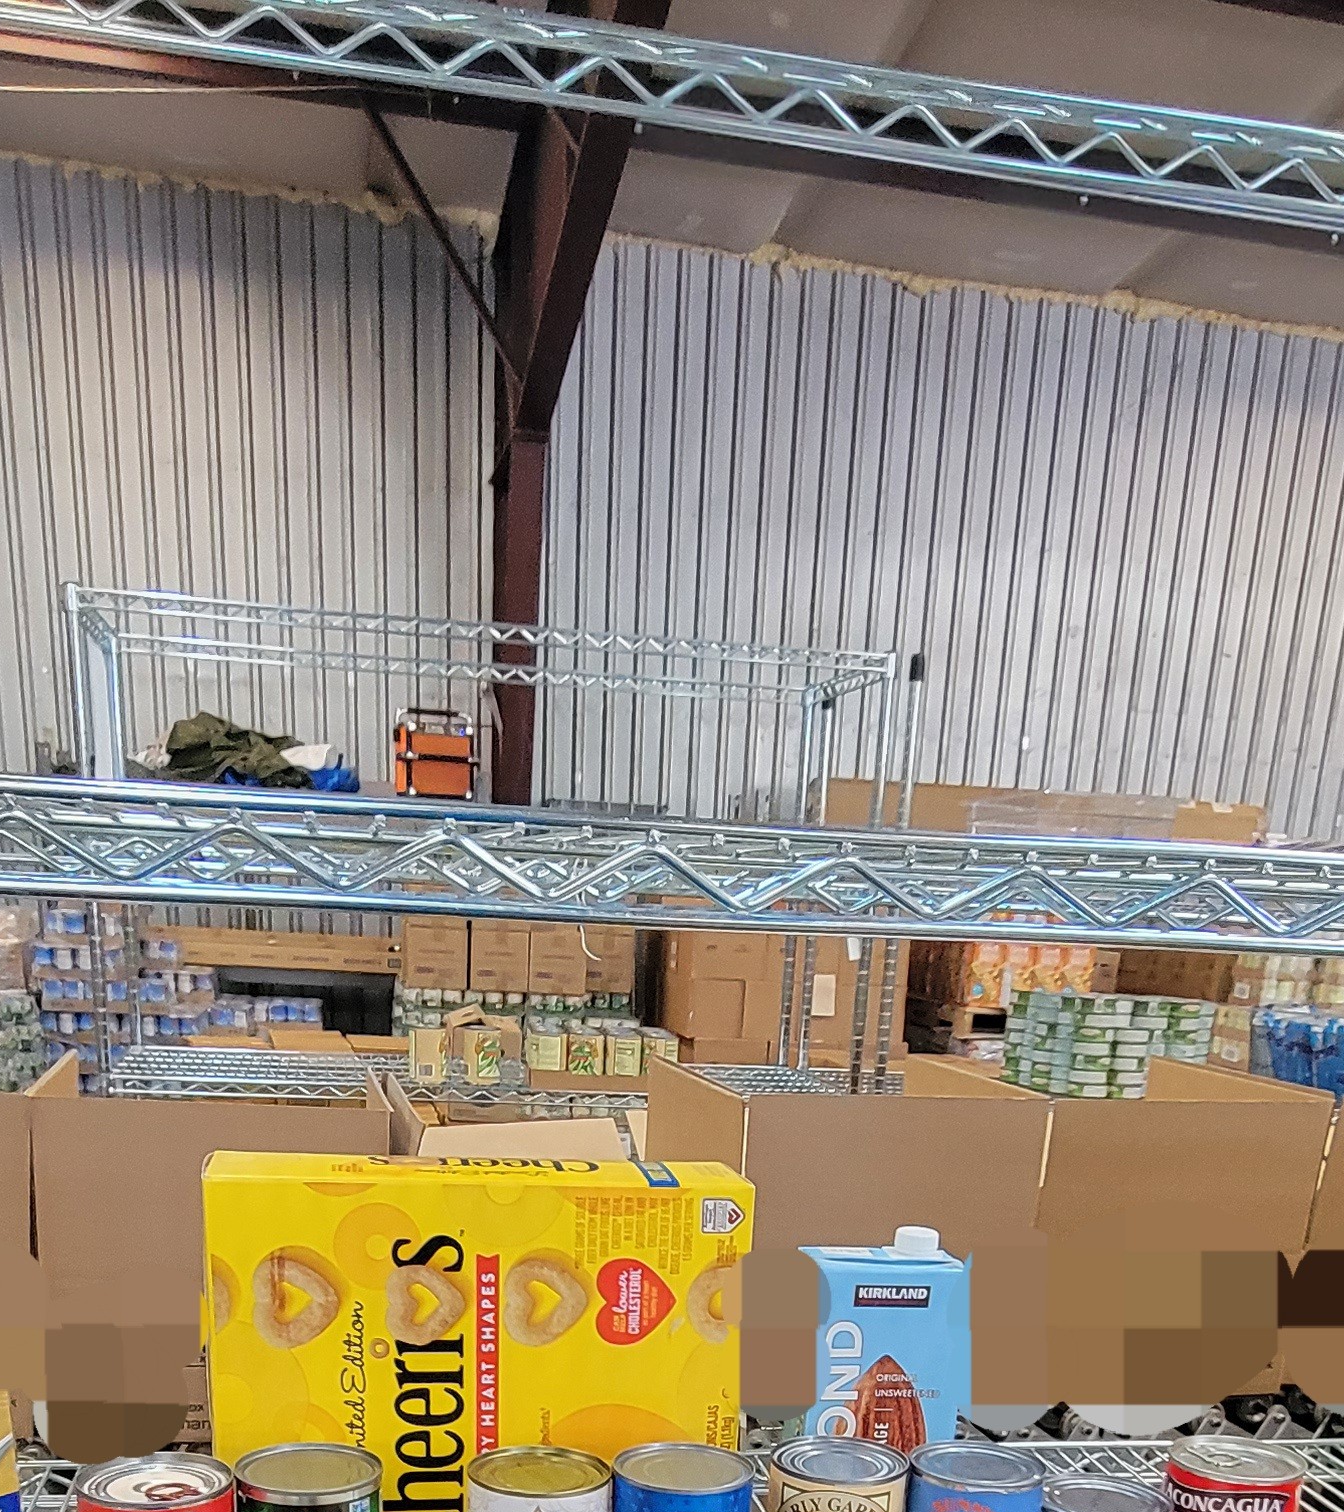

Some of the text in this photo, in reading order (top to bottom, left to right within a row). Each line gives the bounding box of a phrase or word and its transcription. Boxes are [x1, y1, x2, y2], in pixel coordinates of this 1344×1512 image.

[482, 1271, 496, 1352] SHAPES
[612, 1271, 628, 1314] lower
[627, 1268, 643, 1335] CHOLESTEROL
[858, 1286, 928, 1300] KIRKLAND
[481, 1357, 495, 1424] HEART
